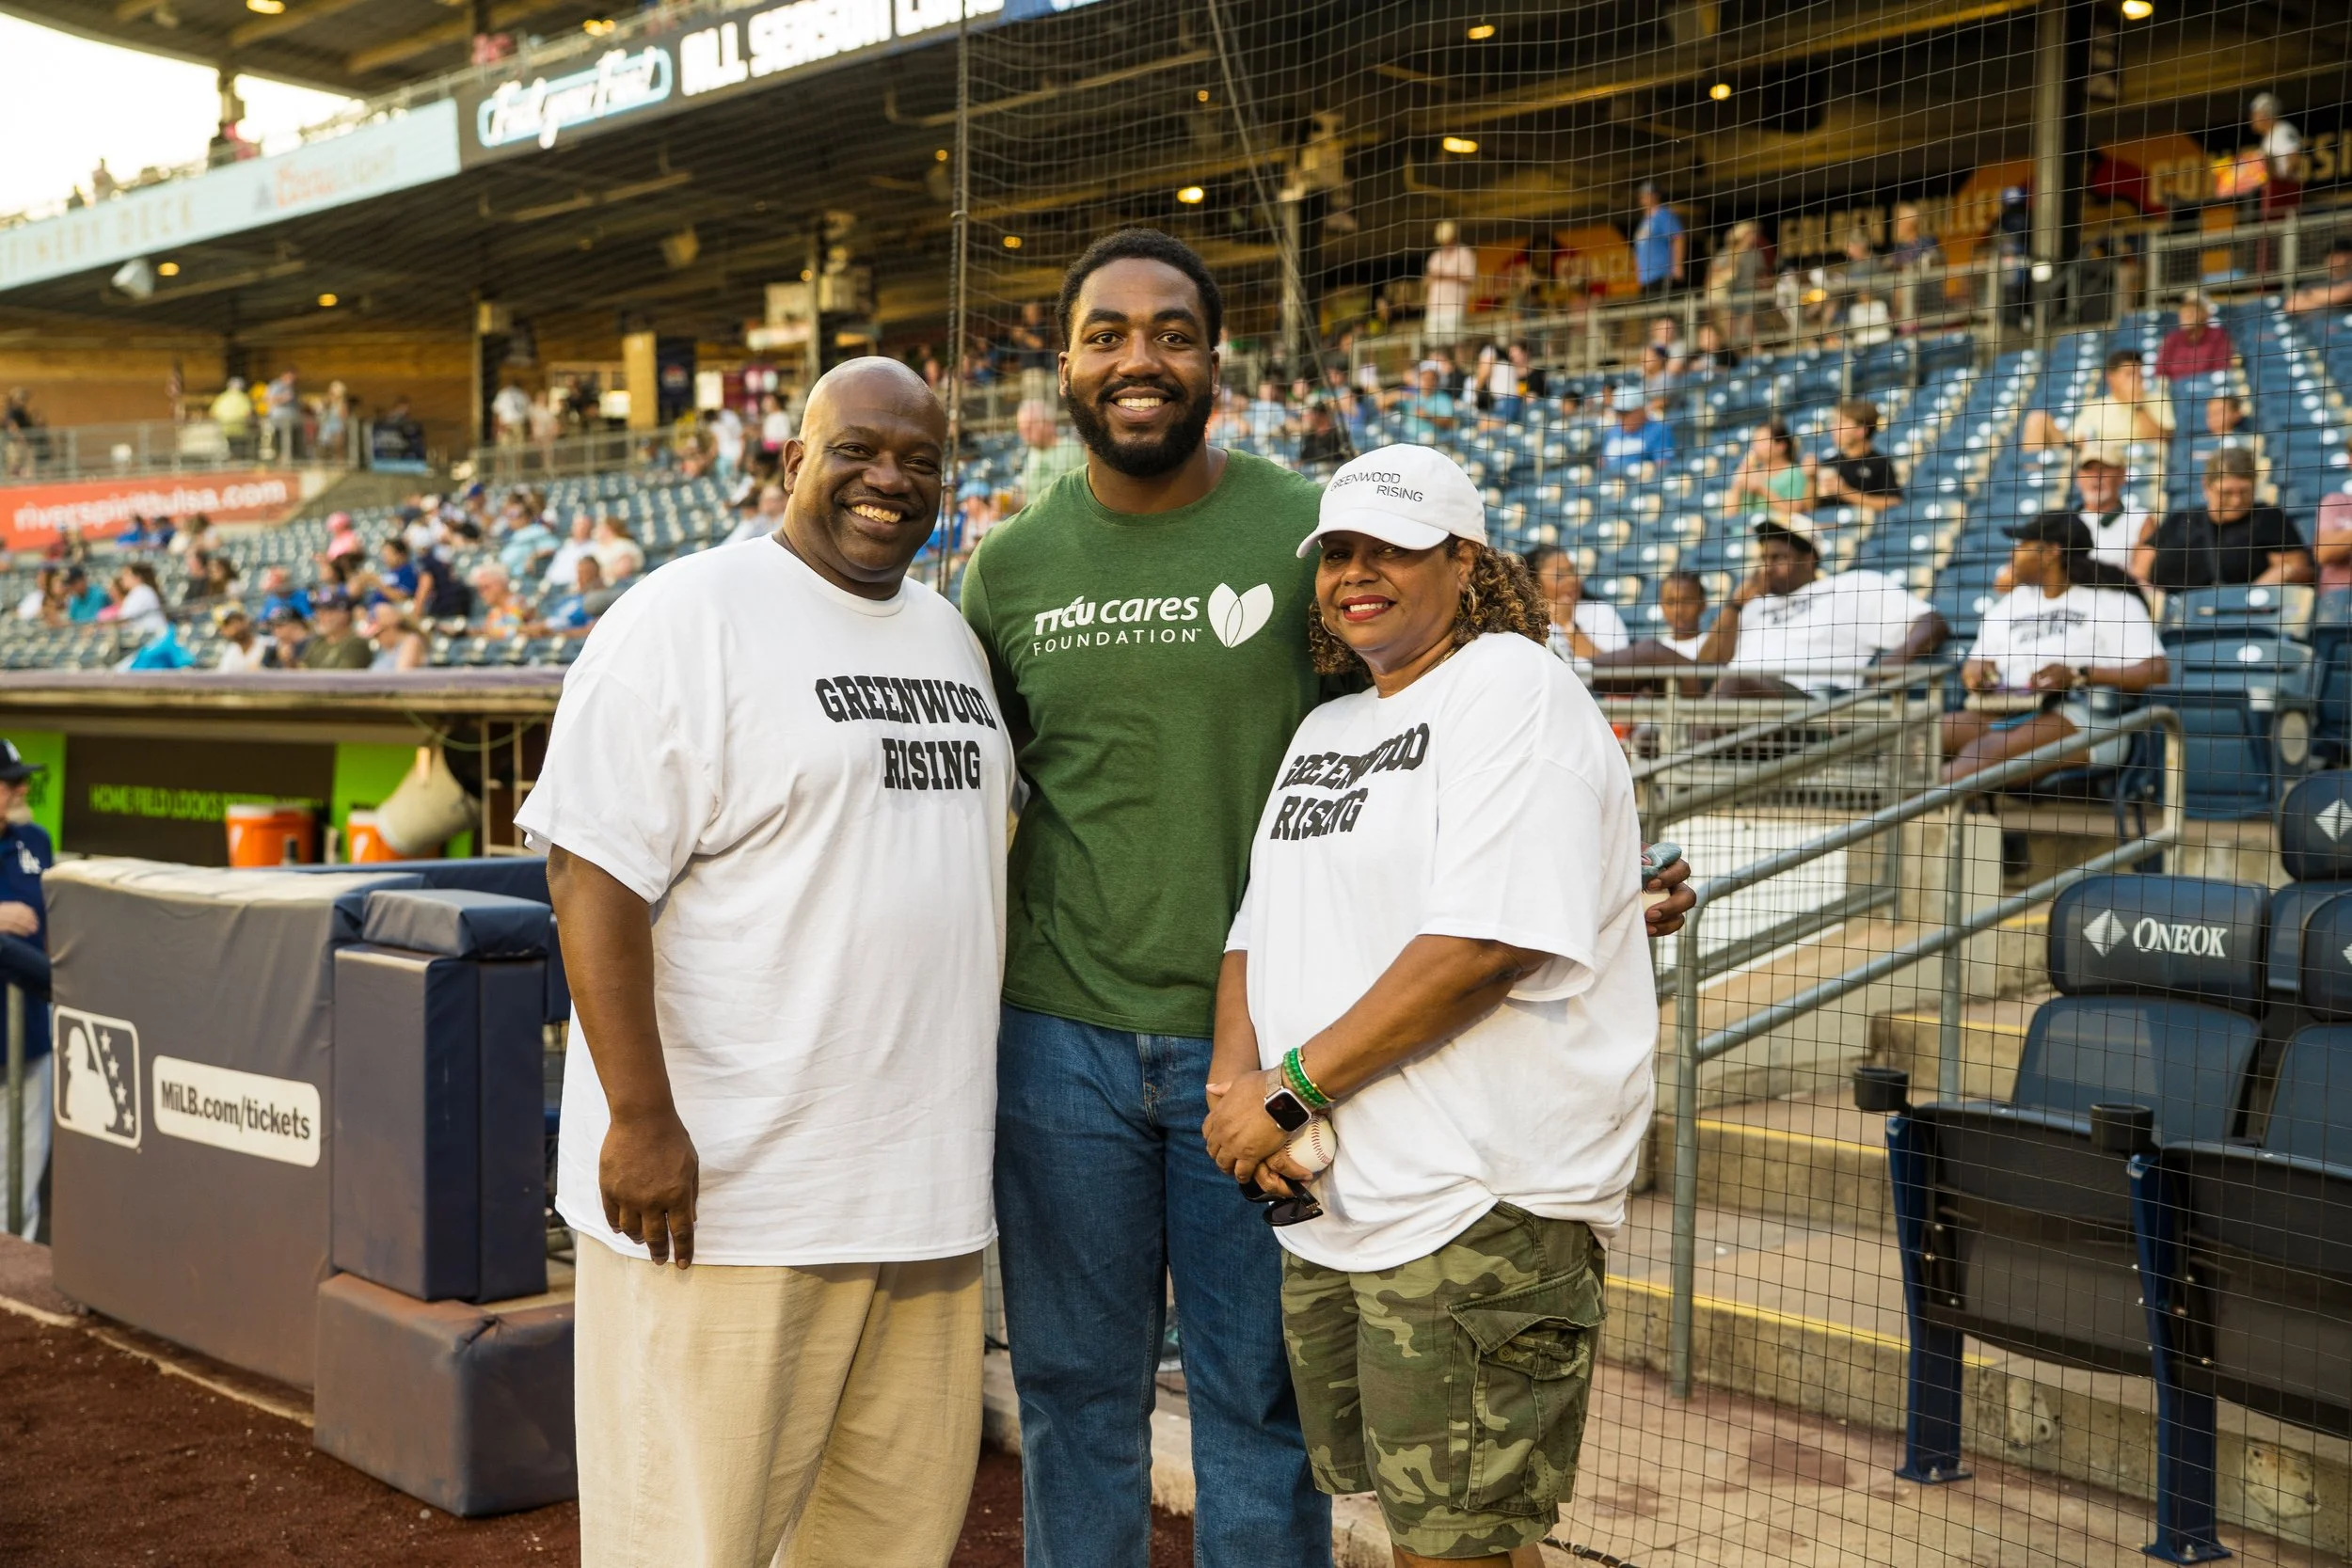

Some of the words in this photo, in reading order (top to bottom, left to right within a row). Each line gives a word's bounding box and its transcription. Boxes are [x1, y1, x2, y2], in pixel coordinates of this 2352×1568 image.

[680, 21, 749, 97] ALL
[1330, 471, 1401, 493] GREENWOOD
[1376, 484, 1423, 503] RISING
[1100, 596, 1200, 625] cares
[815, 674, 997, 731] GREENWOOD
[882, 737, 981, 791] RISING
[2132, 916, 2229, 958] ONEOK
[161, 1079, 310, 1141] MiLB.com/tickets
